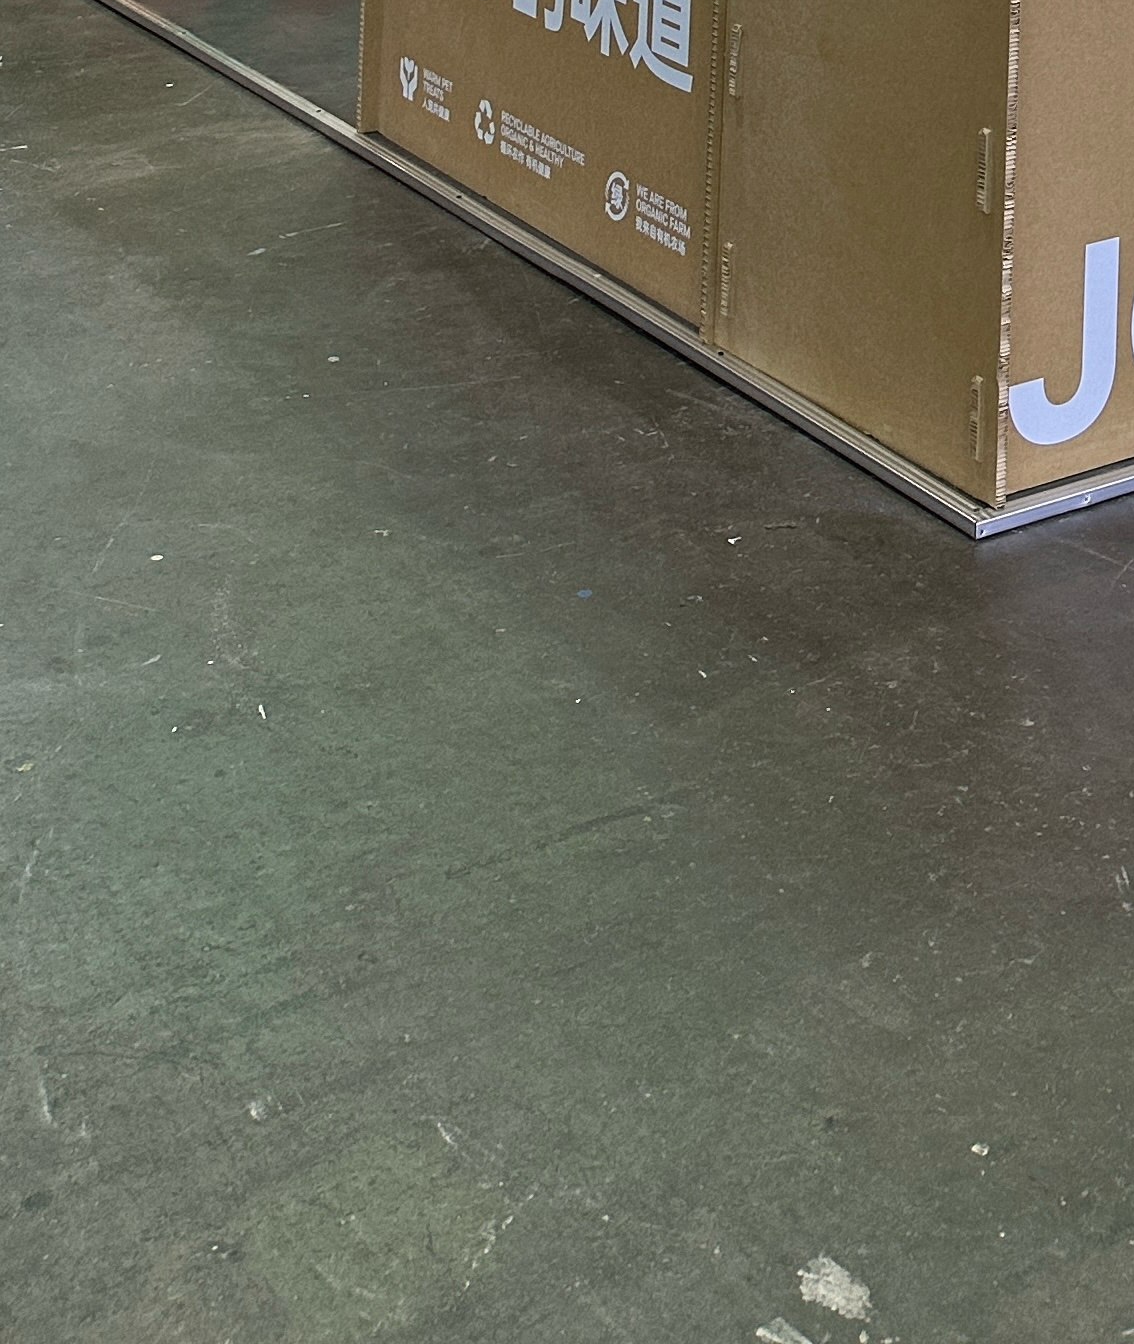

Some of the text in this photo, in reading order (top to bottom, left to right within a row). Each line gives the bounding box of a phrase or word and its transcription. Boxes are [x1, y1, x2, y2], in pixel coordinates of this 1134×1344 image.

[423, 80, 445, 103] TREATS
[442, 77, 453, 93] PET
[636, 183, 688, 223] WE ARE FROM
[635, 200, 691, 240] ORGANIC FARM
